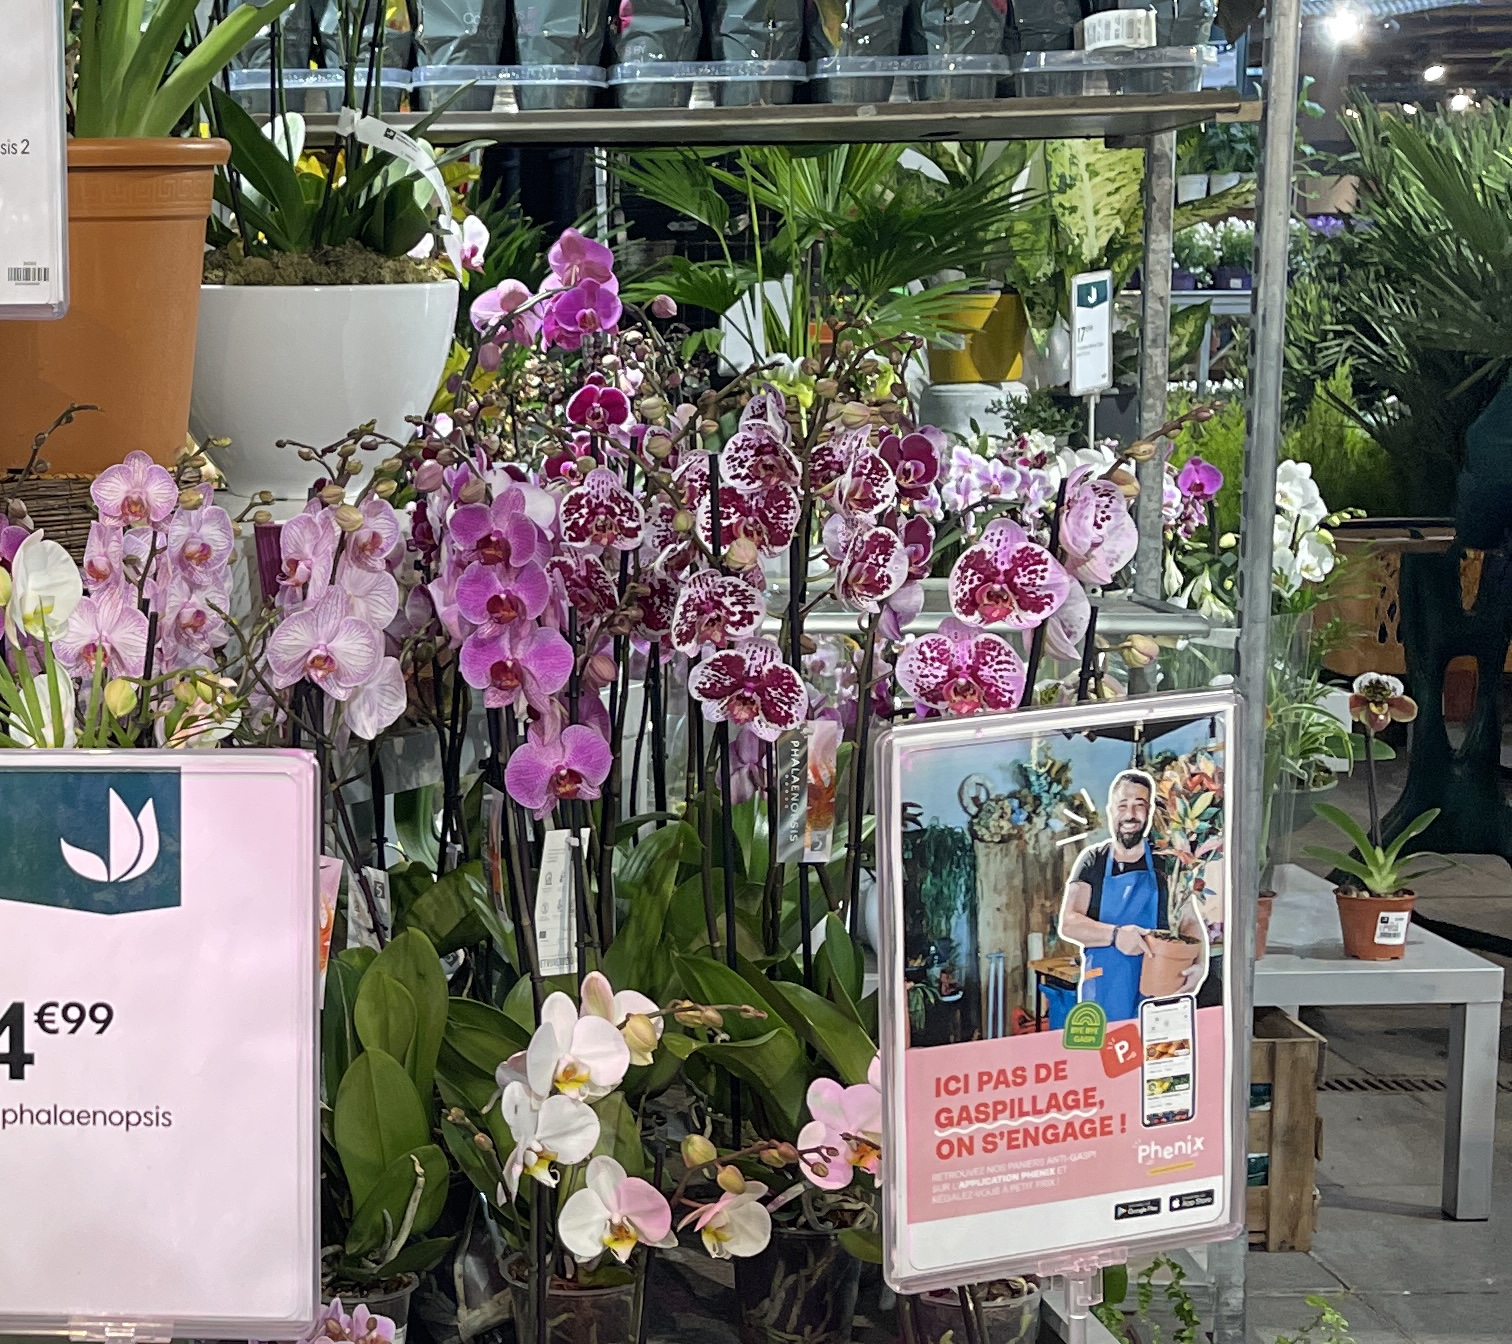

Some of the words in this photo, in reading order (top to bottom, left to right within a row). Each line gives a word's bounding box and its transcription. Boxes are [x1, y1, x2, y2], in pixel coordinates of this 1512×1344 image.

[21, 139, 30, 156] 2
[935, 1074, 970, 1098] ICI
[978, 1067, 1026, 1092] PAS
[1035, 1060, 1068, 1084] DE
[1, 1103, 173, 1131] phalaenopsis
[935, 1087, 1105, 1130] GASPILLAGE,
[936, 1135, 974, 1160] ON
[981, 1115, 1113, 1153] S'ENGAGE
[1120, 1113, 1127, 1133] !
[1138, 1135, 1205, 1165] Phenix
